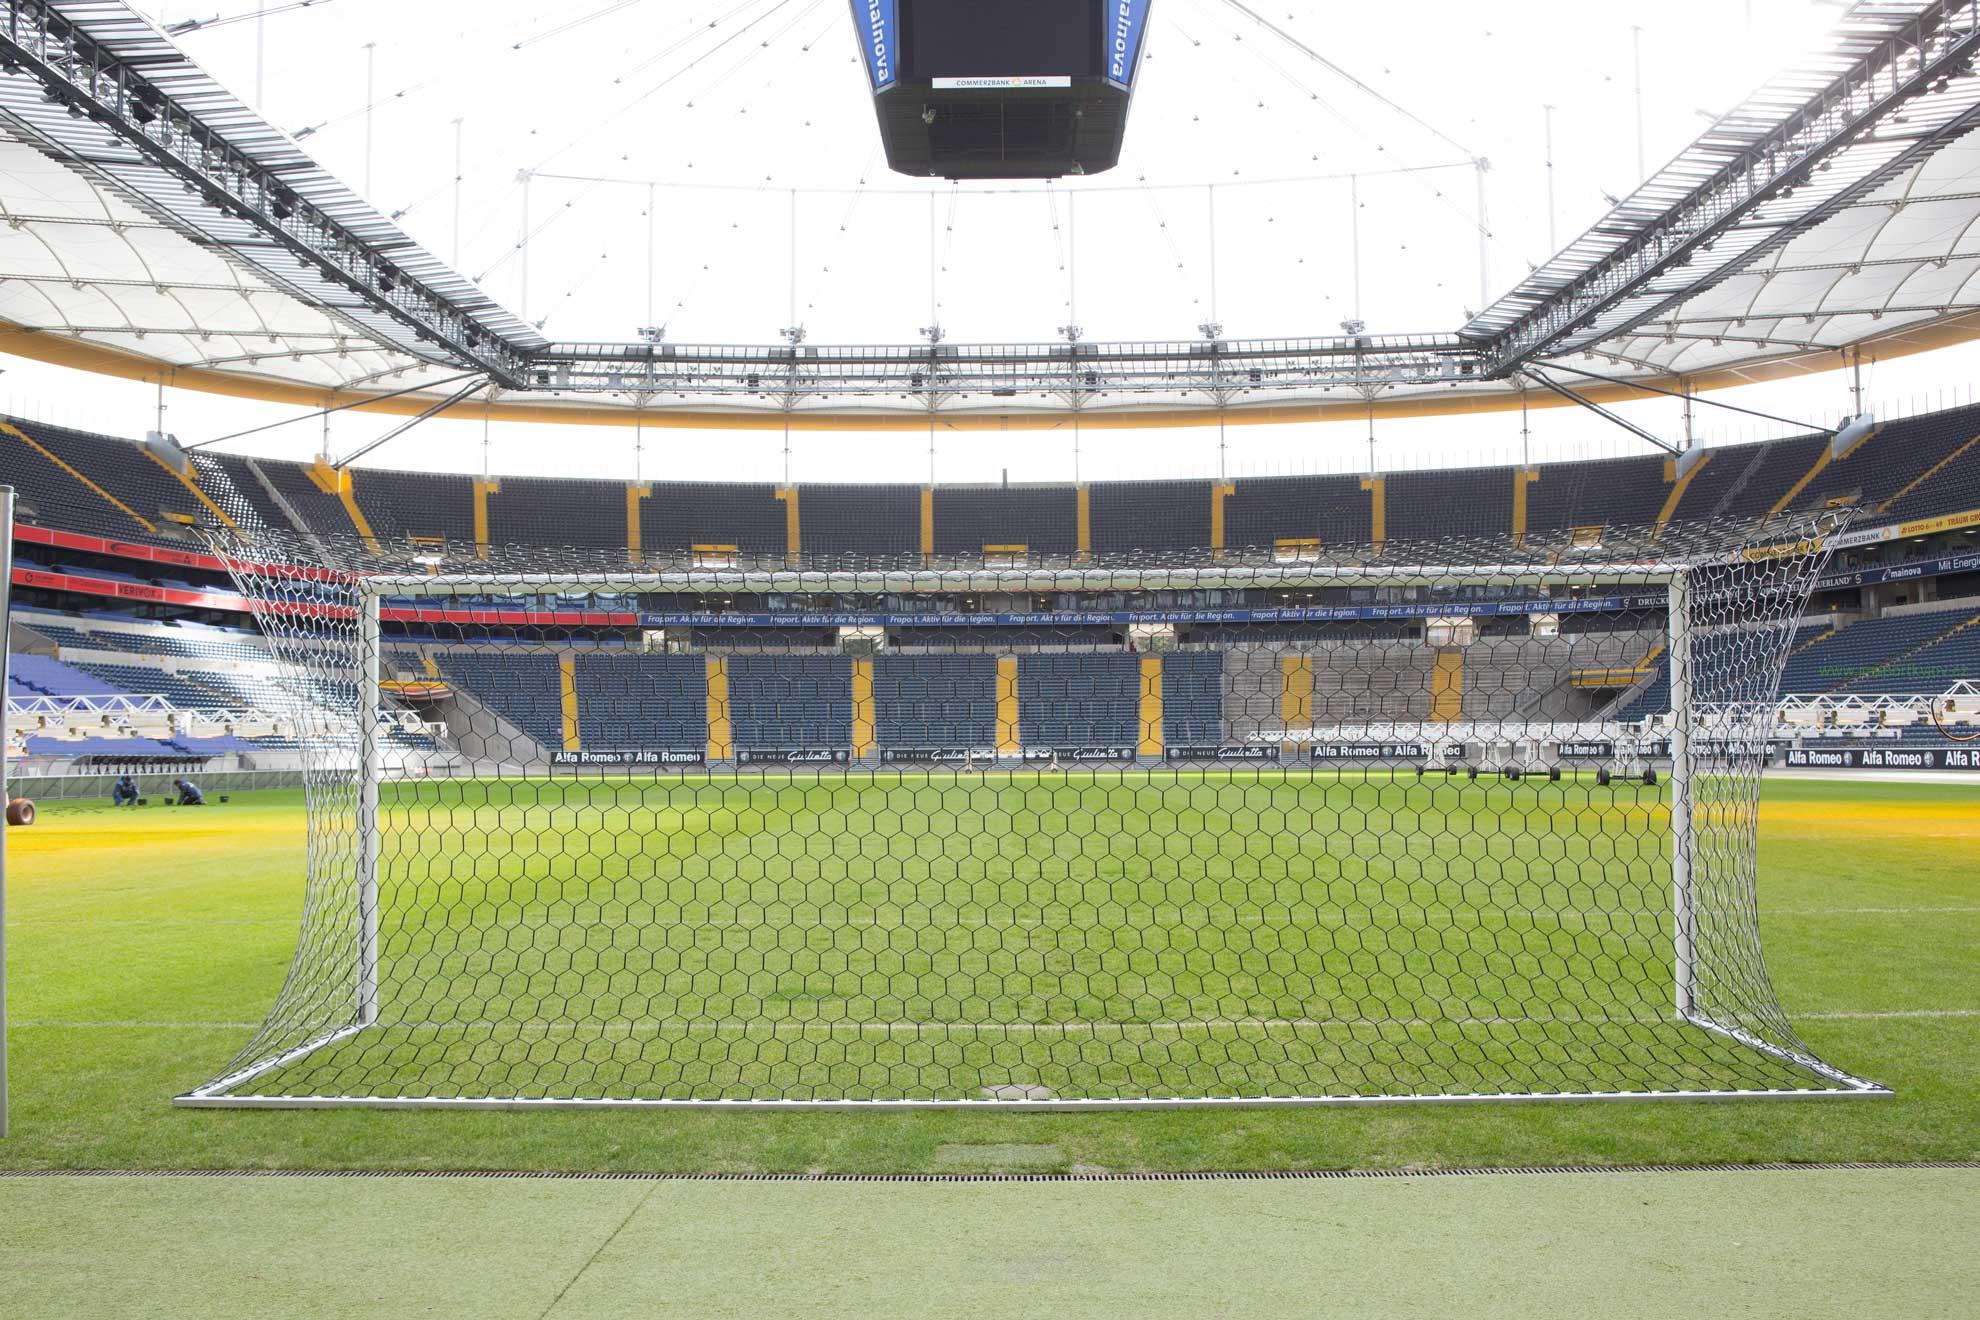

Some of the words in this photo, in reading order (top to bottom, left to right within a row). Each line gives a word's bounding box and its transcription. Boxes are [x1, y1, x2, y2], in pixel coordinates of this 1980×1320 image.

[1112, 0, 1131, 77] ainova
[1907, 525, 1925, 534] LOTTO
[1830, 531, 1880, 546] MMERZBANK
[1939, 560, 1952, 571] Mit
[1890, 566, 1921, 578] mainova
[1813, 577, 1850, 589] AUERLAND
[1281, 610, 1300, 618] Aktiv
[1315, 609, 1327, 618] die
[1453, 605, 1483, 615] Regon.
[802, 615, 820, 624] Aktiv
[835, 615, 846, 623] die
[922, 615, 941, 623] Aktiv
[955, 615, 966, 623] die
[1040, 615, 1059, 623] Aktv
[1206, 611, 1235, 621] Regon.
[1315, 746, 1337, 756] Alfa
[1340, 746, 1380, 756] Romeo
[1395, 746, 1417, 756] Alfa
[1421, 746, 1460, 756] Reo
[582, 752, 621, 762] Romeo
[636, 752, 658, 762] Alfa
[662, 752, 701, 762] Romeo
[1788, 751, 1806, 764] Alfa
[1809, 751, 1842, 764] Romeo
[1862, 751, 1882, 765] Alfa
[1885, 751, 1922, 765] Romeo
[1945, 751, 1967, 766] Alfa
